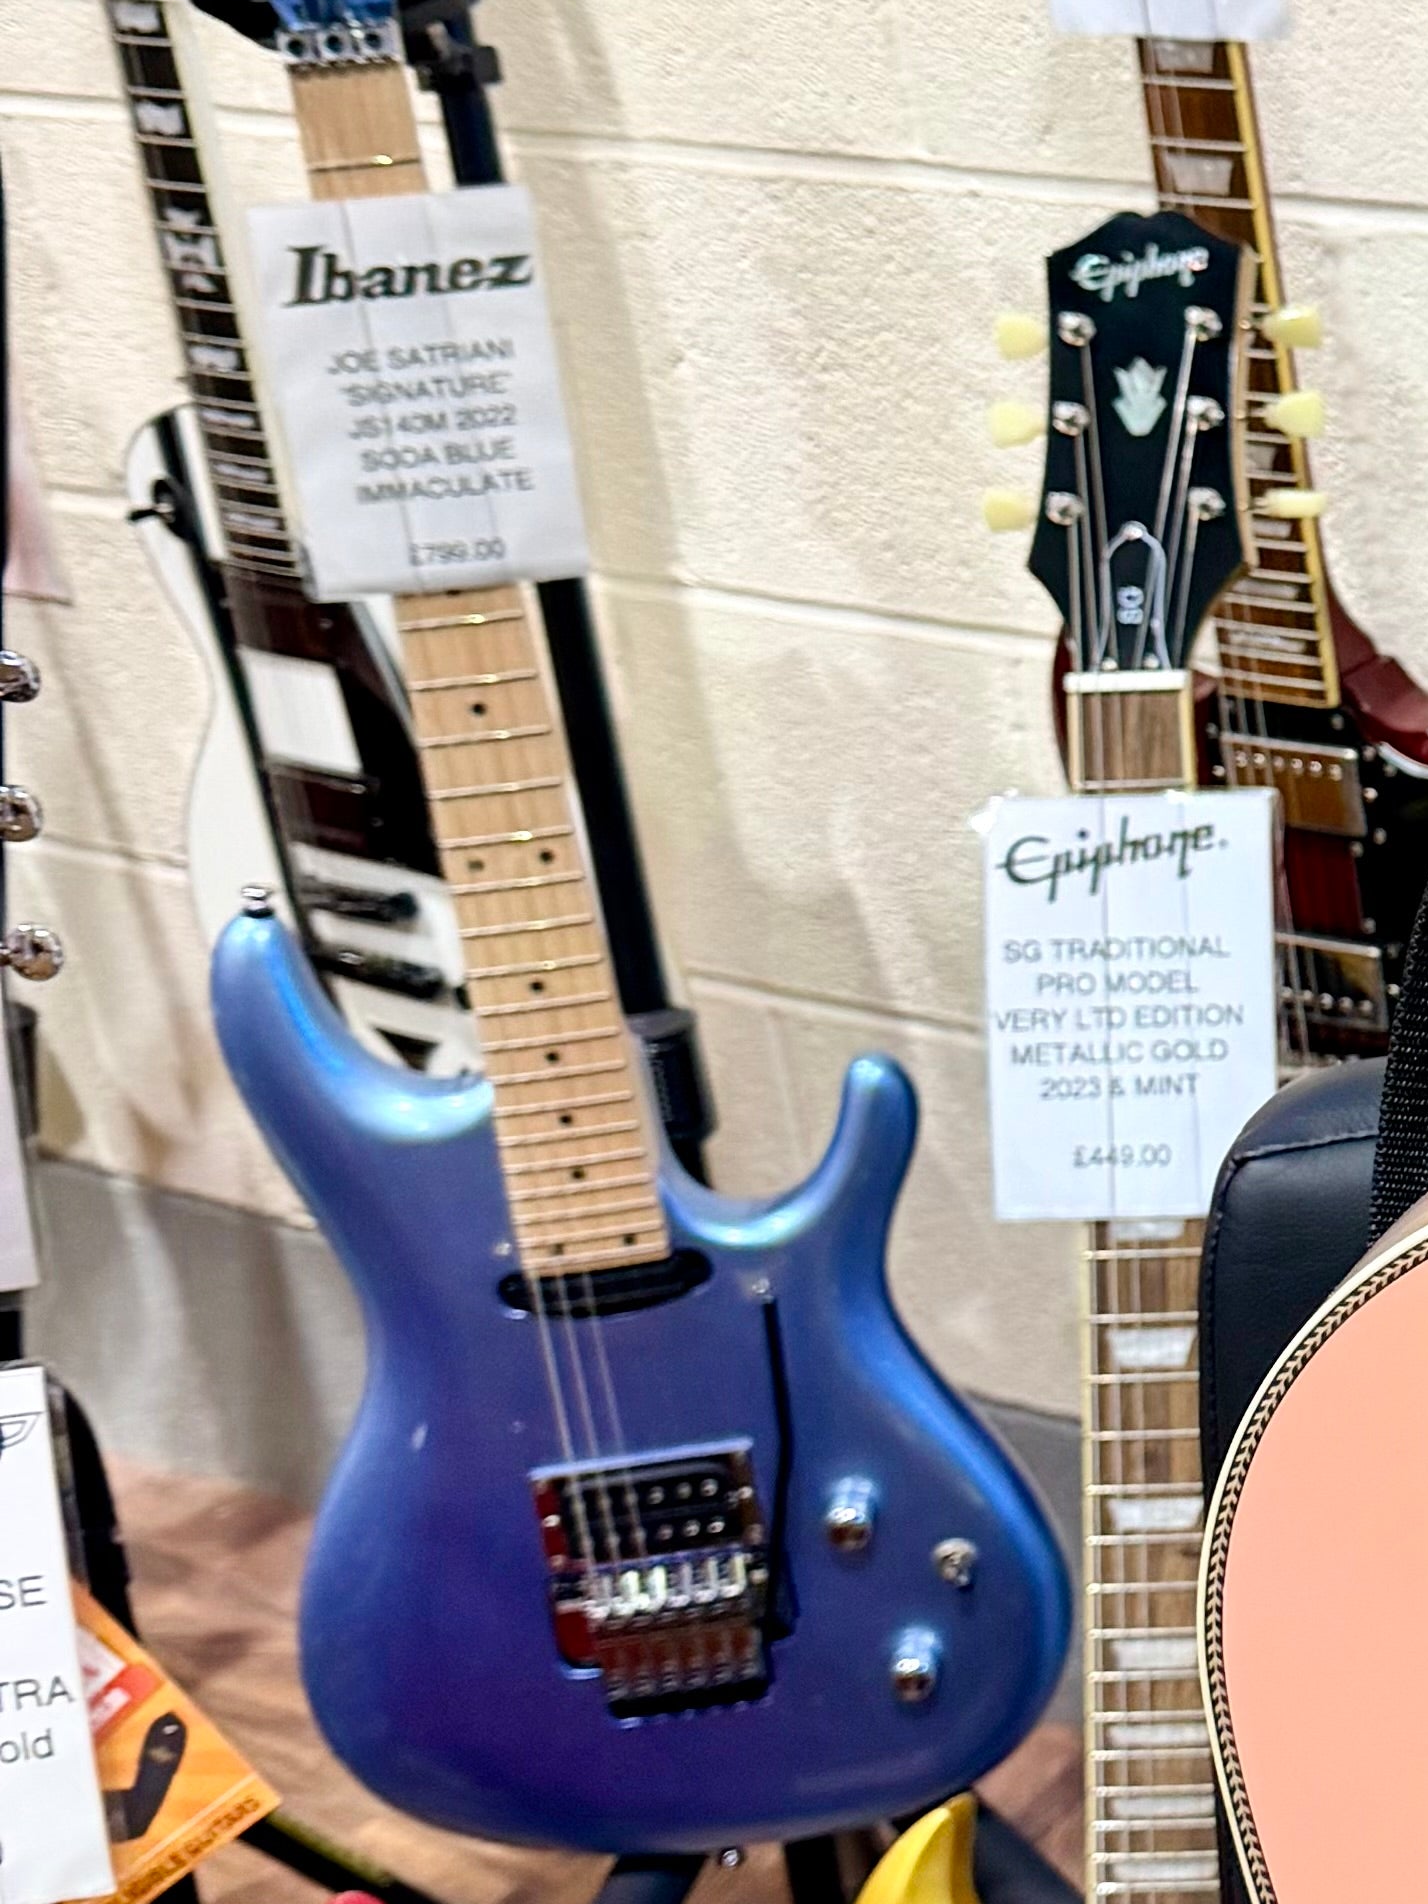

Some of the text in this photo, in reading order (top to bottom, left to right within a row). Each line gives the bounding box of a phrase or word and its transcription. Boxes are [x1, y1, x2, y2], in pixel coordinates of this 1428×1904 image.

[282, 245, 533, 308] Ibanez
[1068, 242, 1210, 303] Epiphone
[327, 338, 516, 375] JOE SATRIANI
[457, 402, 517, 431] 2022
[360, 435, 516, 473] SODA BLUE
[356, 468, 537, 504] IMMACULATE
[1003, 936, 1231, 964] SG TRADITIONAL
[1037, 970, 1200, 996] PRO MODEL
[996, 1003, 1245, 1033] VERY LTD EDITION
[1011, 1038, 1230, 1066] METALLIC GOLD
[1040, 1075, 1101, 1101] 2023
[1134, 1072, 1202, 1097] MINT
[1072, 1143, 1173, 1169] £449.00
